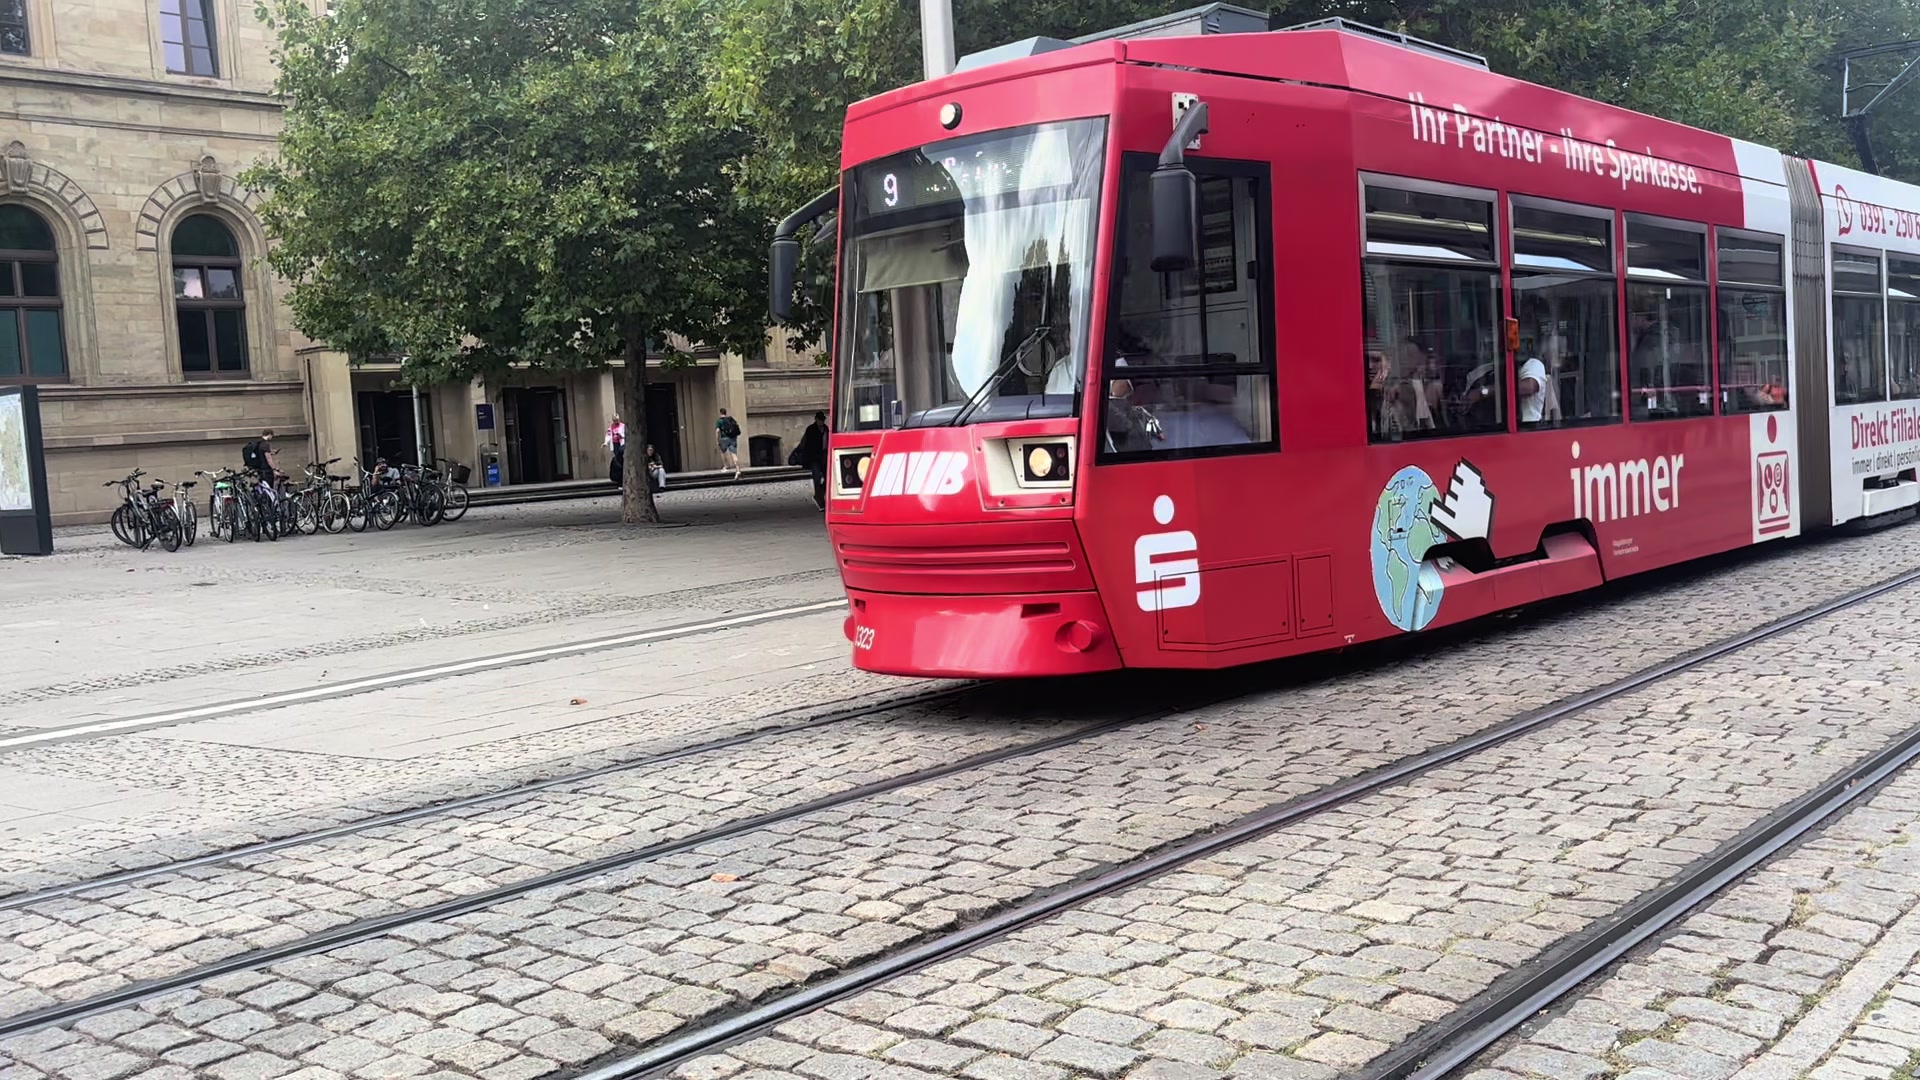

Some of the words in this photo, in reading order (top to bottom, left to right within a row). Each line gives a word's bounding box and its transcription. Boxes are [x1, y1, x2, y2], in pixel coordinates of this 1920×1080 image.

[1408, 91, 1448, 145] Ihr
[1452, 103, 1543, 163] Partner
[1560, 127, 1604, 177] Ihre
[1607, 138, 1702, 195] Sparkasse.
[884, 173, 898, 207] 9
[1860, 203, 1887, 235] 0391
[1895, 211, 1914, 239] 250
[1851, 410, 1889, 450] Direkt
[1891, 406, 1920, 443] Filiale
[1852, 457, 1872, 475] immer
[1876, 450, 1894, 470] direkt
[1570, 440, 1684, 523] immer
[855, 625, 875, 650] 1323
